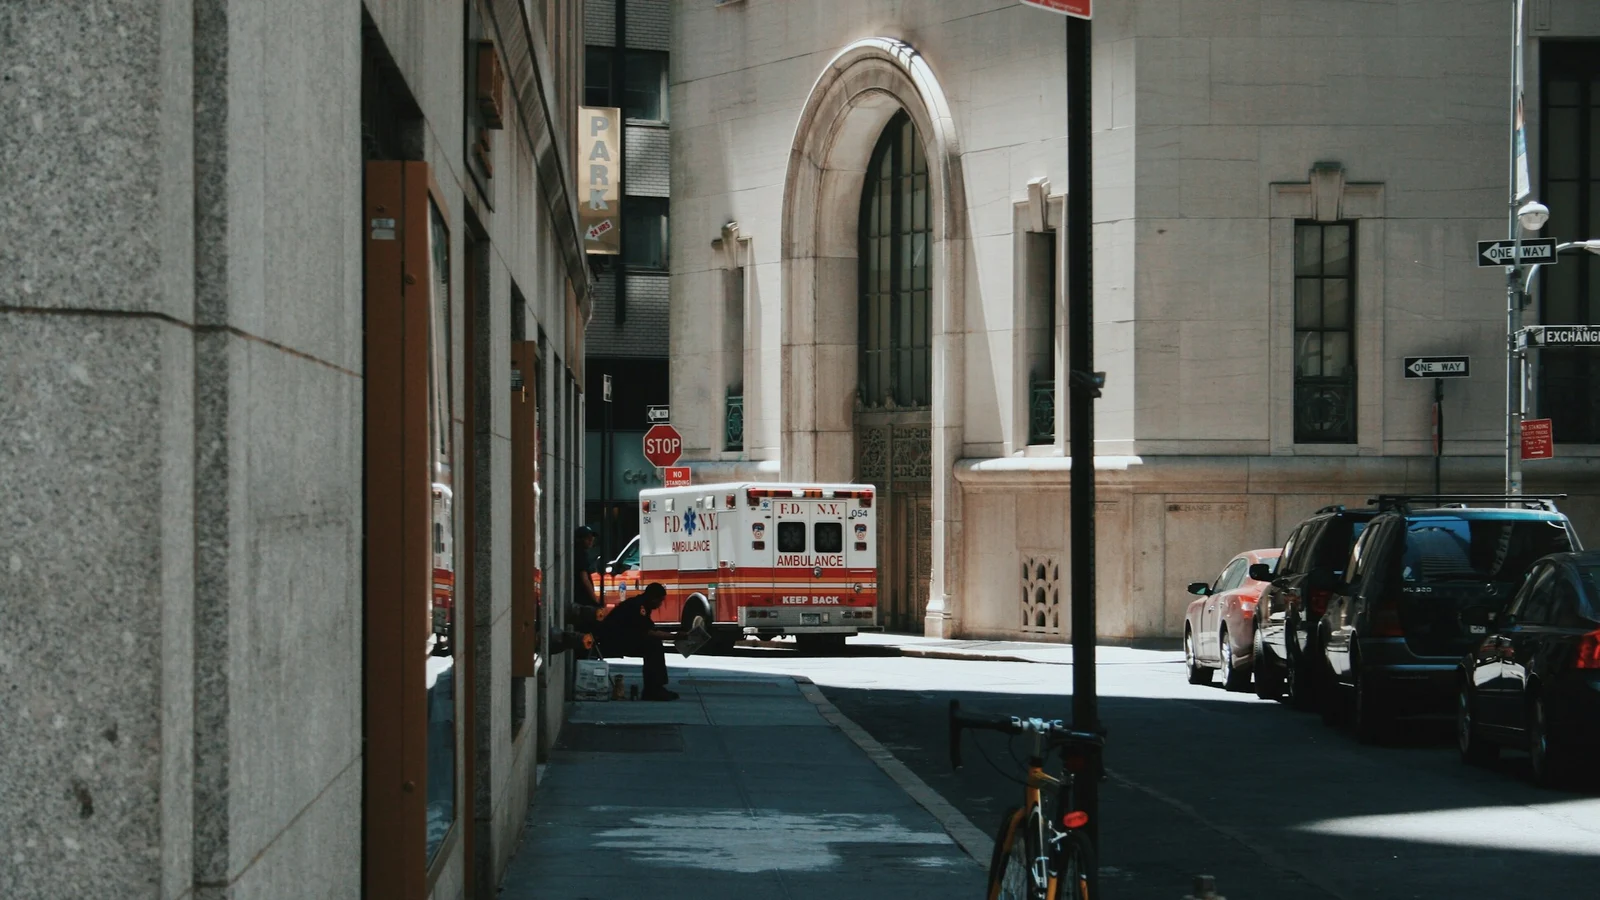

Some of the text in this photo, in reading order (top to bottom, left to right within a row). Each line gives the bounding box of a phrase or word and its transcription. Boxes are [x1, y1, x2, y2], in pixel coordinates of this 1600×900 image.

[589, 116, 611, 210] PARK
[590, 221, 611, 238] 24 HRS
[1490, 246, 1547, 259] ONE WAY
[1414, 362, 1462, 372] ONE WAY
[647, 438, 680, 454] STOP
[780, 503, 840, 515] F.D. N.Y.
[851, 509, 868, 518] 054
[664, 515, 683, 533] F.D.
[671, 540, 710, 552] AMBULANCE
[776, 555, 843, 567] AMBULANCE
[782, 595, 839, 604] KEEP BACK
